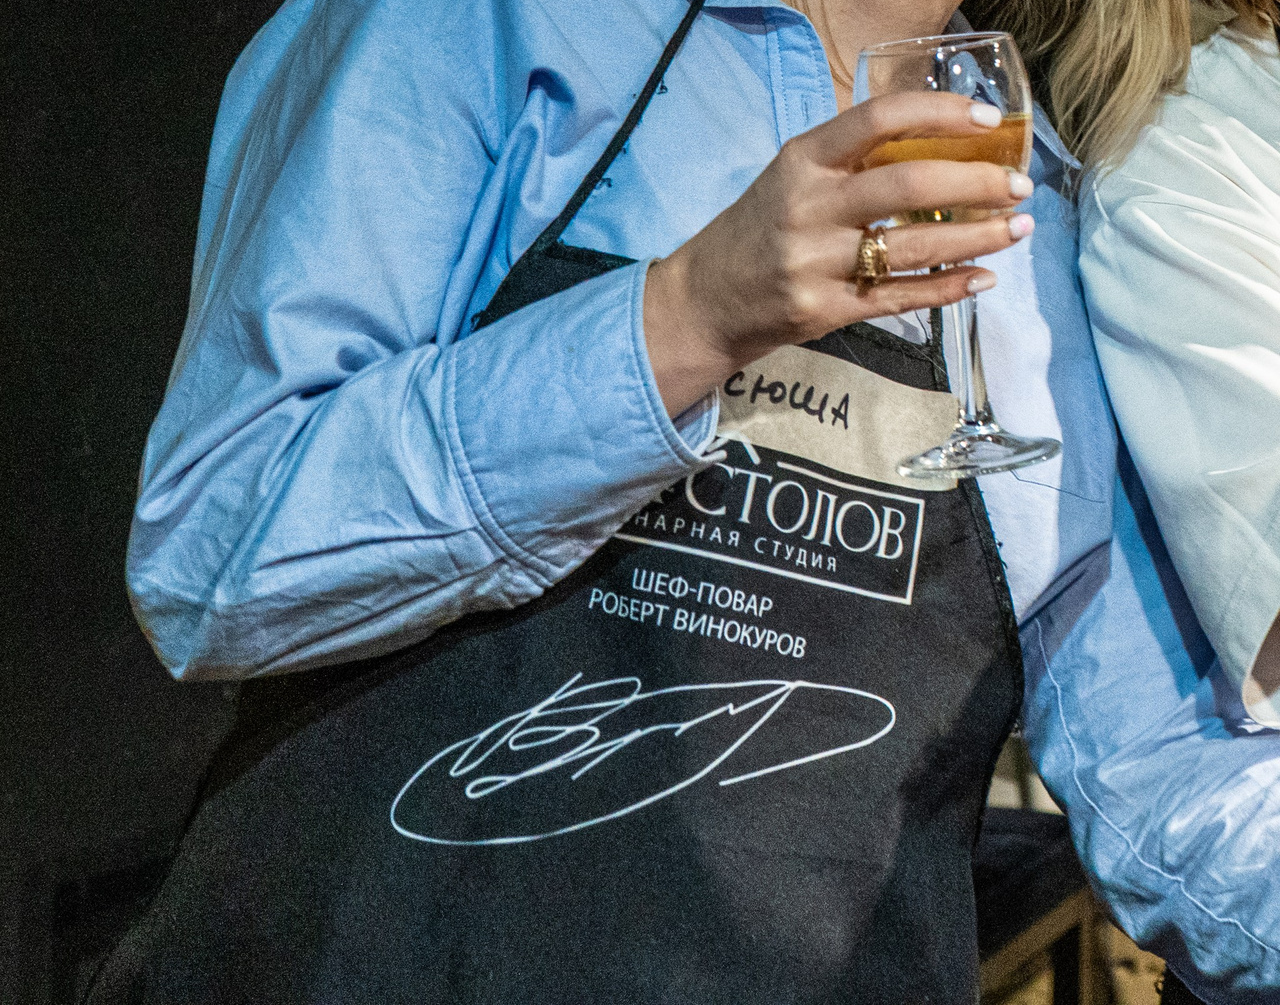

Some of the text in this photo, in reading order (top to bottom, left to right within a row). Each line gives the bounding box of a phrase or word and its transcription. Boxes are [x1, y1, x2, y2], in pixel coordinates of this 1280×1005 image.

[723, 370, 850, 430] СЮША
[634, 511, 838, 573] НАРНАЯ СТУДИЯ
[685, 462, 907, 560] СТОЛОВ
[632, 567, 774, 618] ШЕФ-ПОВАР
[588, 589, 807, 659] РОБЕРТ ВИНОКУРОВ
